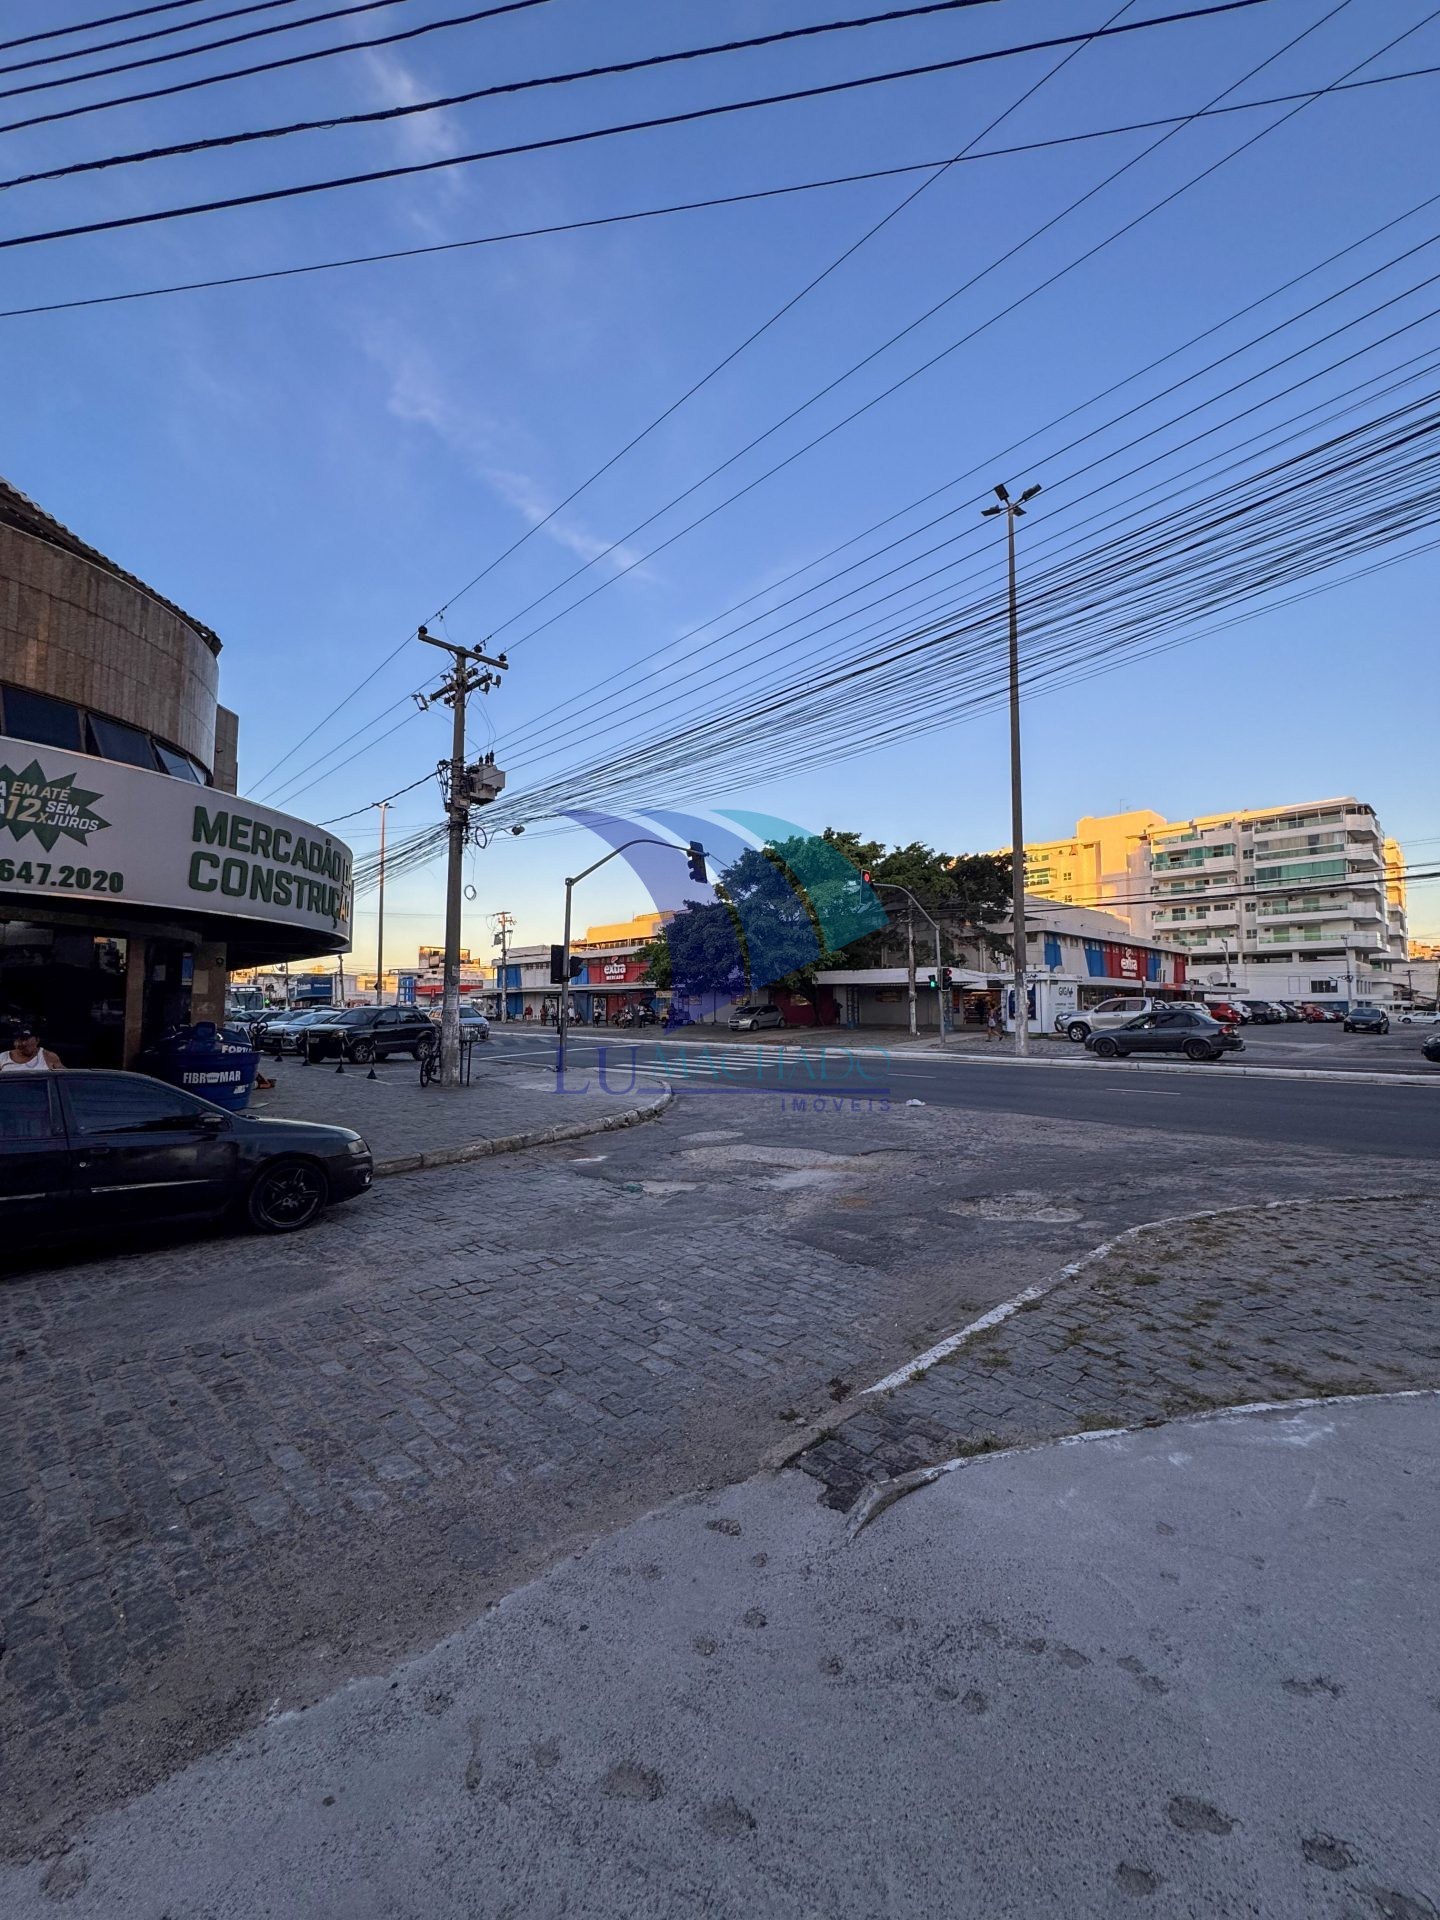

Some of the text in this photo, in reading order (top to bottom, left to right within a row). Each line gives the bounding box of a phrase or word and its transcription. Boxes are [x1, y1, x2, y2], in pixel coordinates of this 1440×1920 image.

[11, 782, 71, 801] EM ATÉ
[46, 801, 80, 816] SEM
[48, 814, 99, 831] JUROS
[192, 805, 341, 881] MERCADÃO
[0, 859, 124, 894] 647.2020
[604, 963, 627, 974] extra
